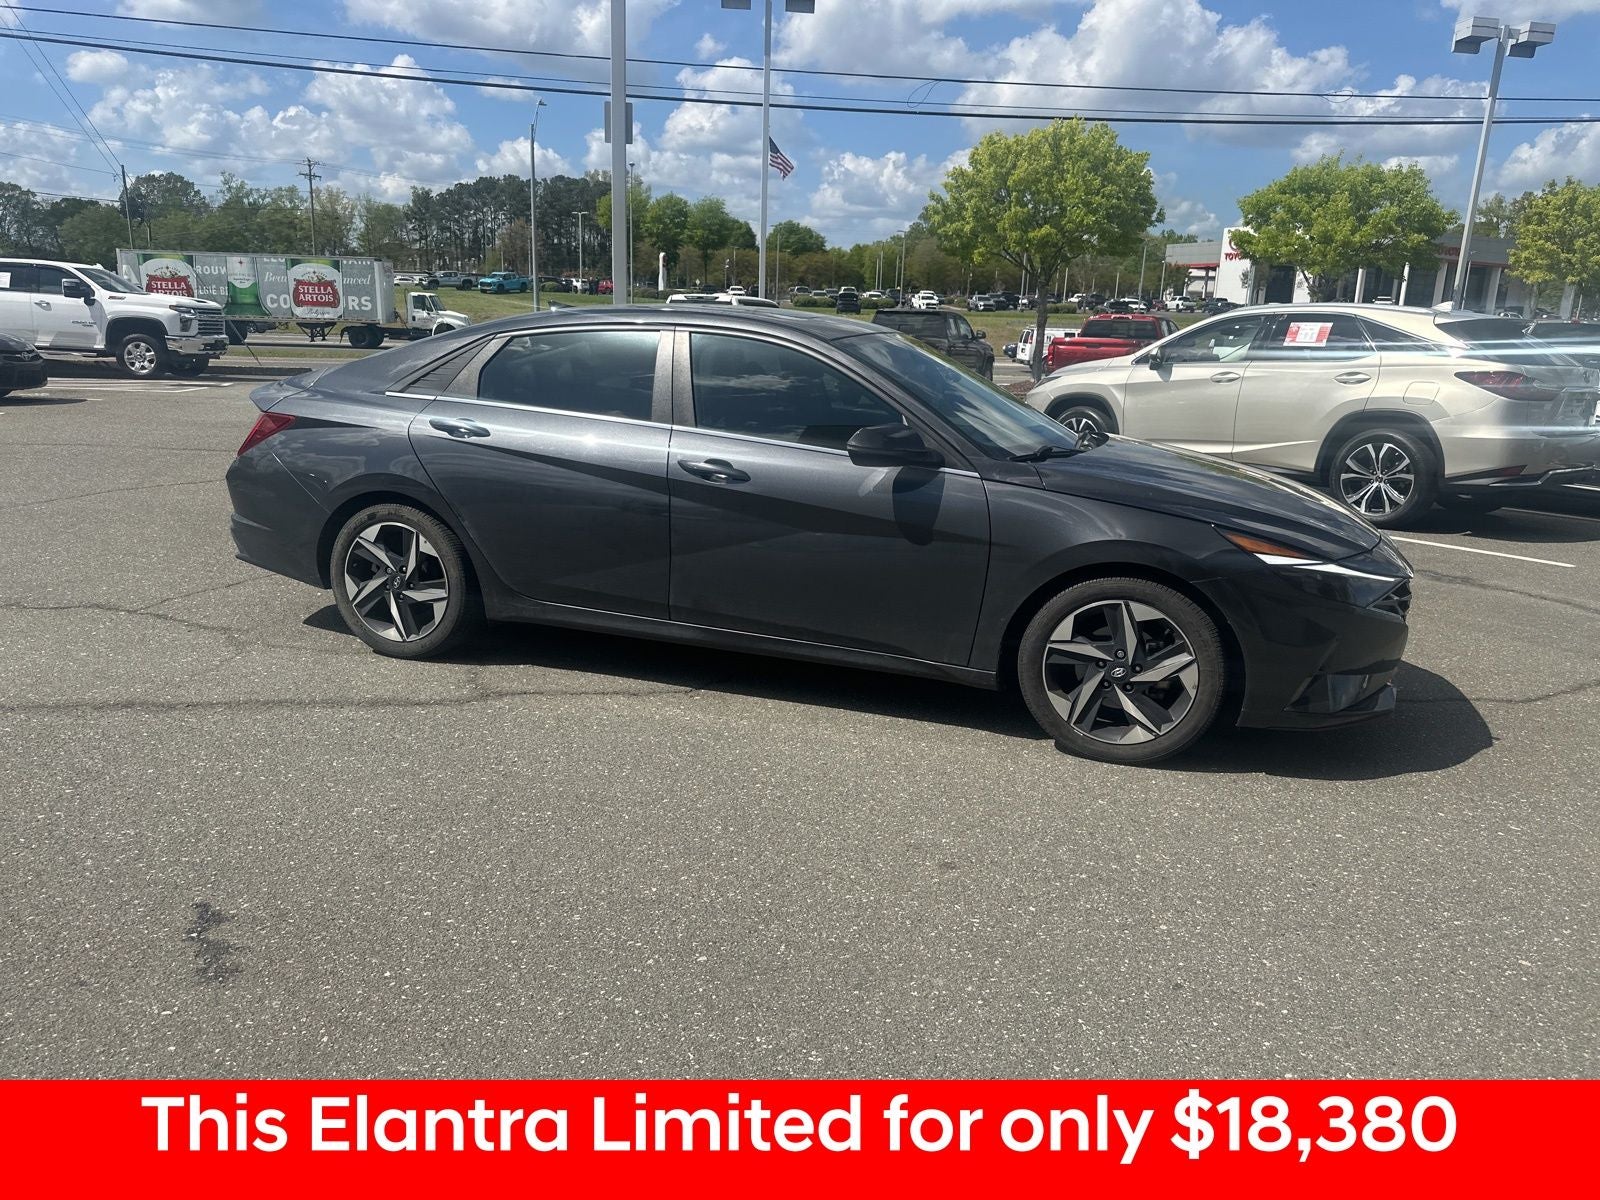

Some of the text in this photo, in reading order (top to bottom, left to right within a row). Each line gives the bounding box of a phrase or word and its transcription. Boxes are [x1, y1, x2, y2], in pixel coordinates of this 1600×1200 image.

[151, 280, 187, 289] STELLA
[298, 285, 333, 294] STELLA
[299, 293, 334, 302] ARTOIS
